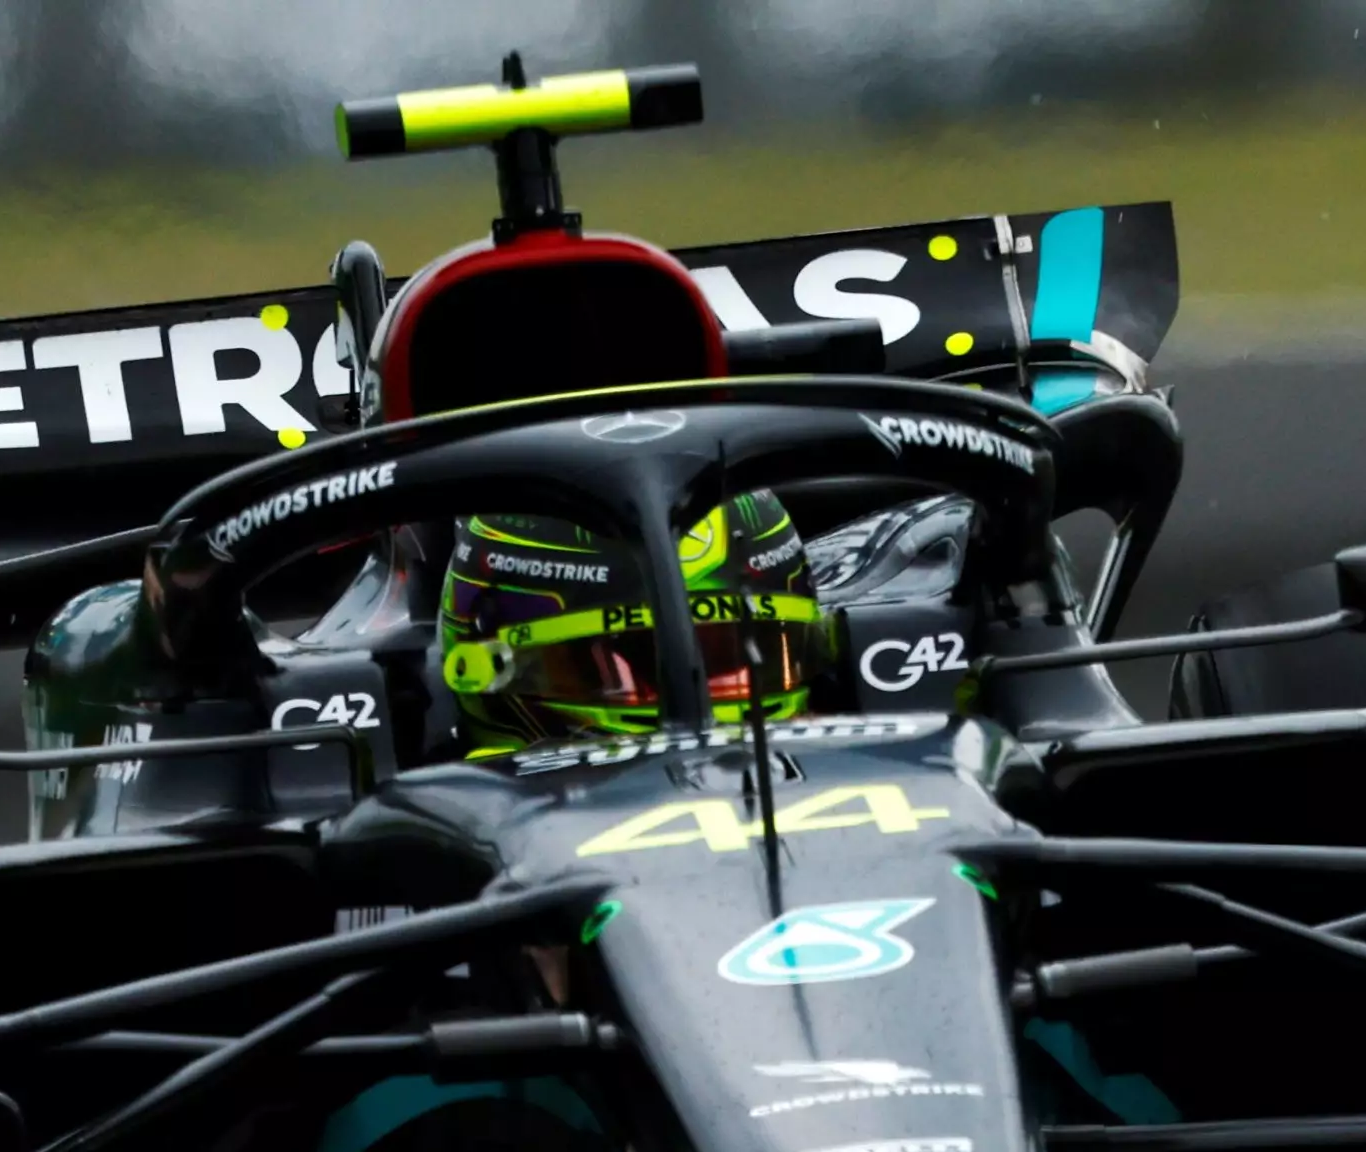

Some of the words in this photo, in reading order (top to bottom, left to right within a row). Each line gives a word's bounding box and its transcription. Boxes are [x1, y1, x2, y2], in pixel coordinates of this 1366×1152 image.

[215, 461, 398, 549] CROWDSTRIKE
[486, 552, 610, 582] CROWDSTRIKE
[860, 632, 969, 692] G42
[576, 784, 950, 857] 44
[748, 1083, 985, 1117] CROWDSTRIKE
